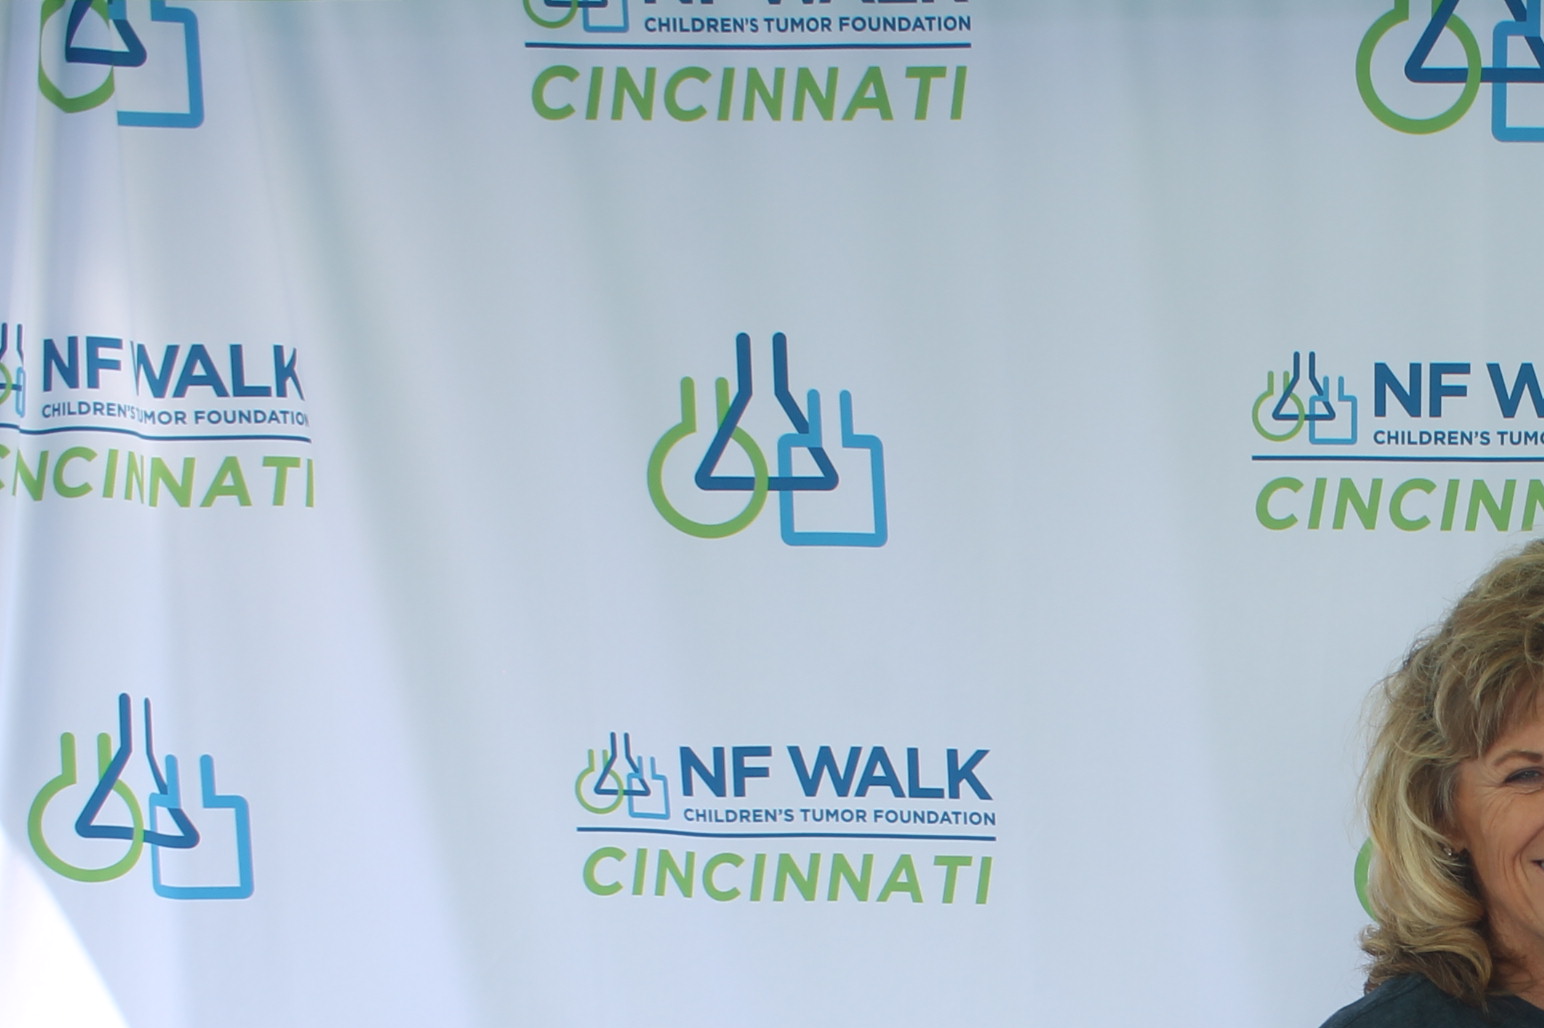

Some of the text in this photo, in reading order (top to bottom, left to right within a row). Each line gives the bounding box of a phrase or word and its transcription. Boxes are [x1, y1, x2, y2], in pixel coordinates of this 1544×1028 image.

[644, 15, 972, 33] CHILDREN'S TUMOR FOUNDATION
[531, 64, 968, 122] CINCINNATI
[43, 336, 306, 401] NF WALK
[1373, 362, 1471, 418] NF
[42, 401, 135, 419] CHILDREN'S
[136, 407, 188, 425] UMOR
[1373, 430, 1491, 446] CHILDREN'S
[0, 443, 315, 508] NCINNATI
[679, 745, 995, 800] NF WALK
[683, 808, 997, 826] CHILDREN'S TUMOR FOUNDATION
[582, 846, 993, 905] CINCINNATI
